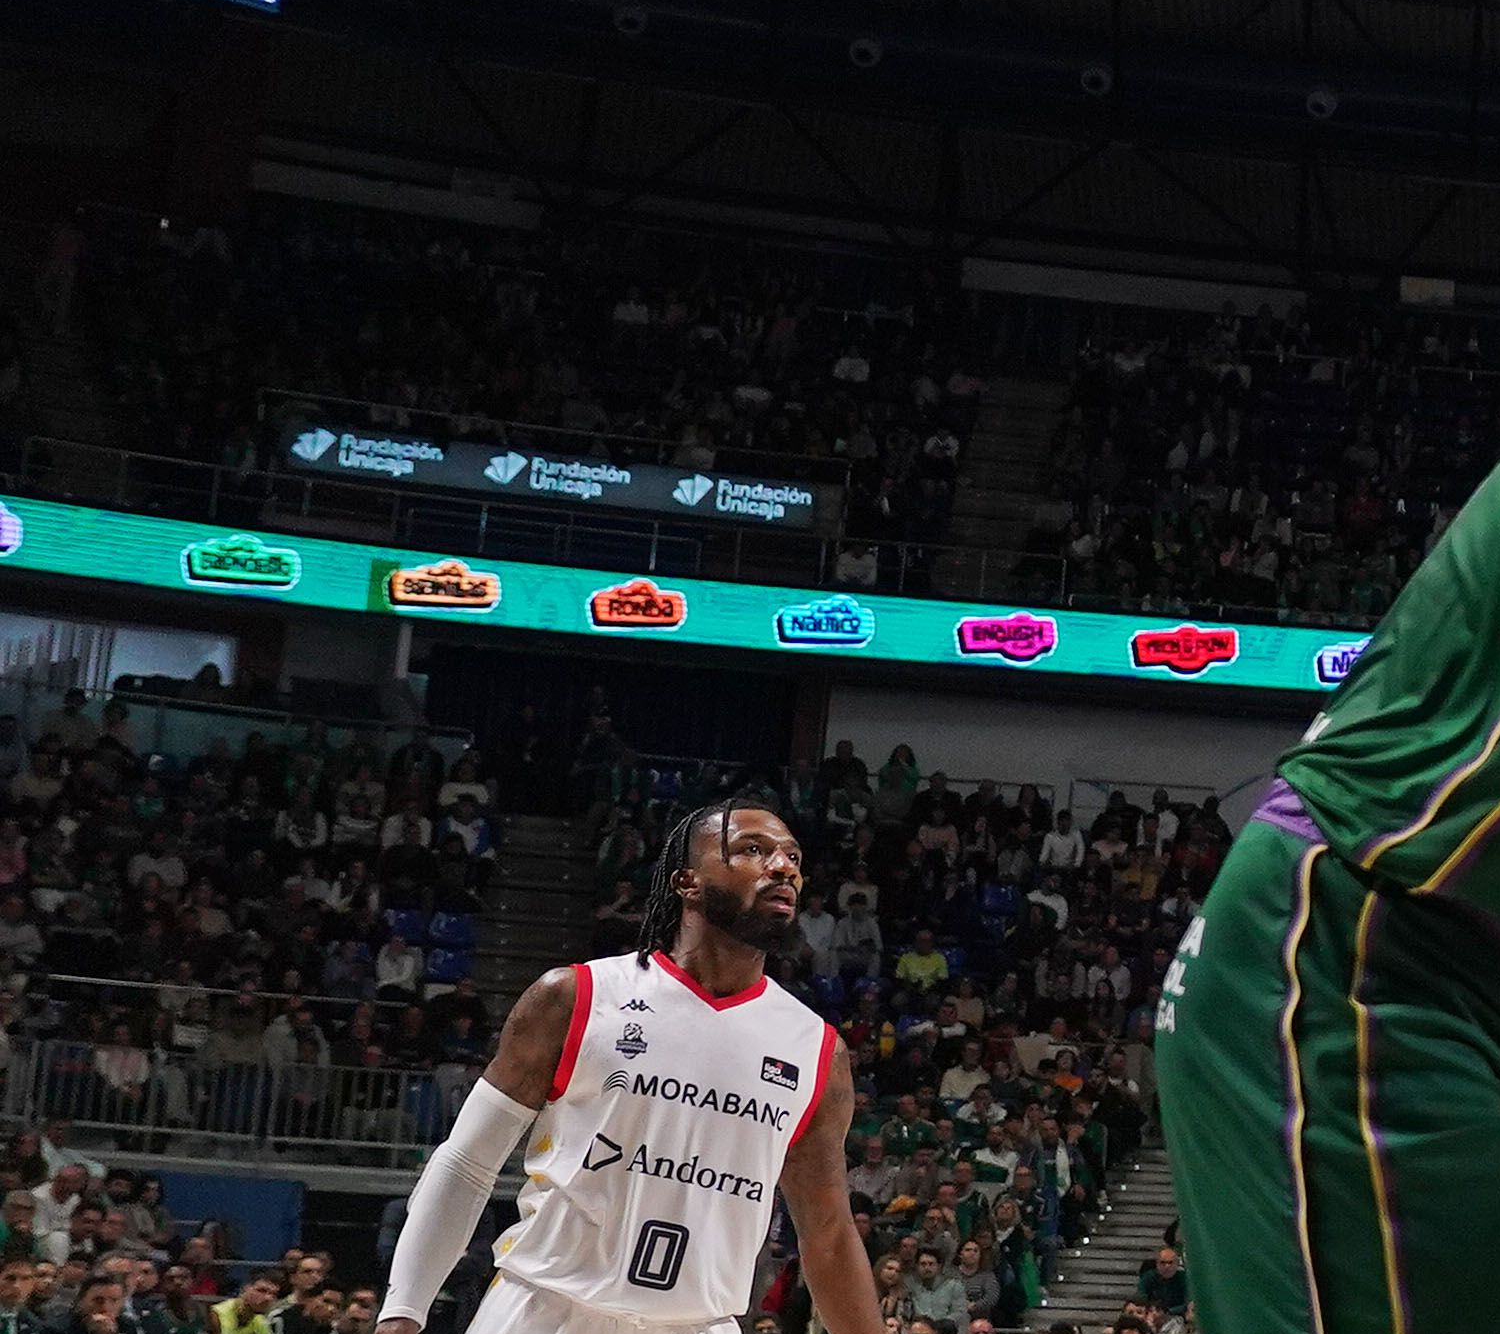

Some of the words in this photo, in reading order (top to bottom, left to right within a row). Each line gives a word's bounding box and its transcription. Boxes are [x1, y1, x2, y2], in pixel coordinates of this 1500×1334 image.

[529, 470, 602, 500] Unicaja
[530, 456, 632, 485] Fundación
[715, 493, 786, 521] Unicaja
[717, 478, 813, 506] Fundación
[631, 1073, 790, 1131] MORABANC
[627, 1144, 763, 1203] Andorra
[628, 1220, 690, 1291] 0
